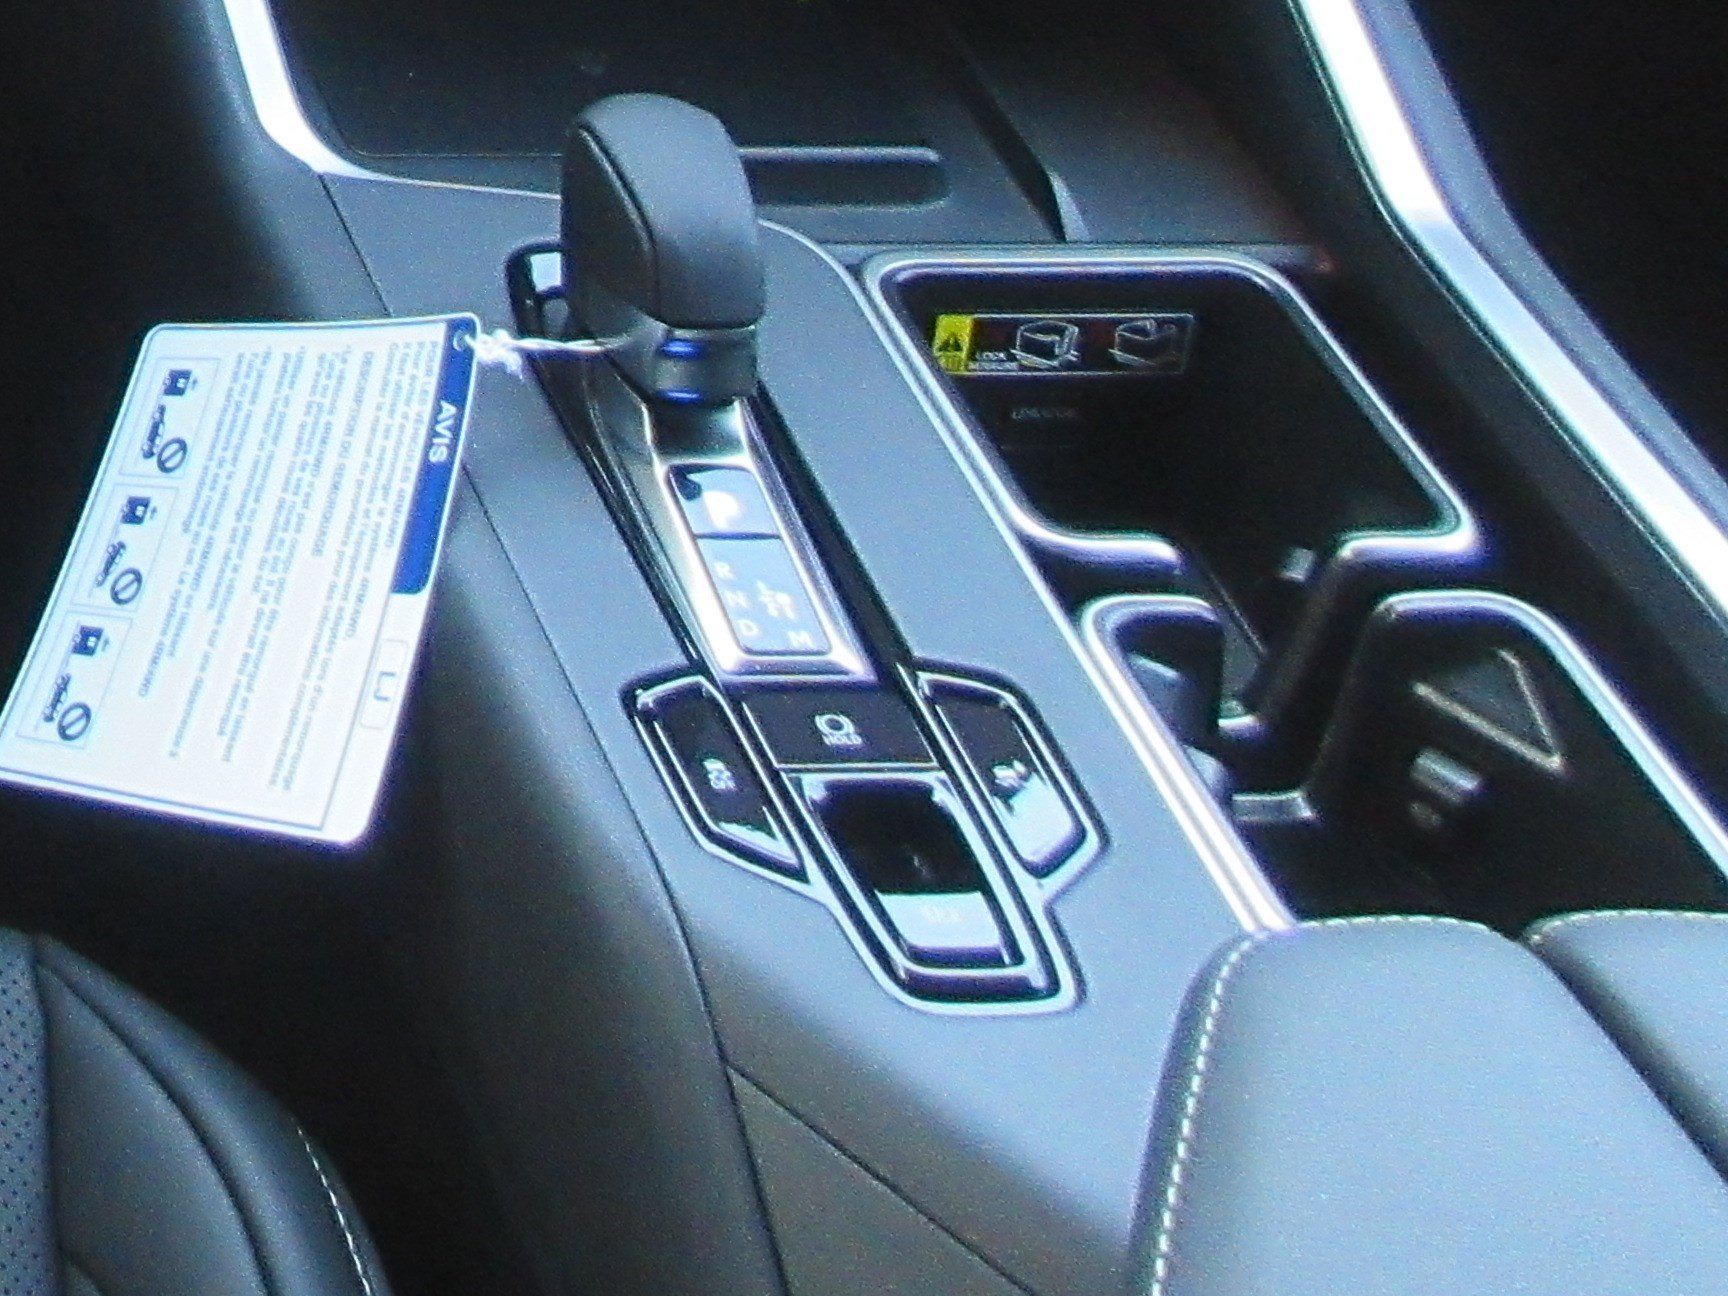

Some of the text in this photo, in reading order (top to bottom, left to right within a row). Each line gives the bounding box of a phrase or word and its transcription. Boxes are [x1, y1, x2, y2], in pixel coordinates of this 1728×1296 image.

[341, 351, 375, 436] DESCRIPTION
[426, 400, 459, 463] AVIS
[310, 462, 346, 556] REMORQUAGE
[705, 491, 739, 529] P
[789, 631, 814, 648] M
[823, 730, 863, 746] HOLD
